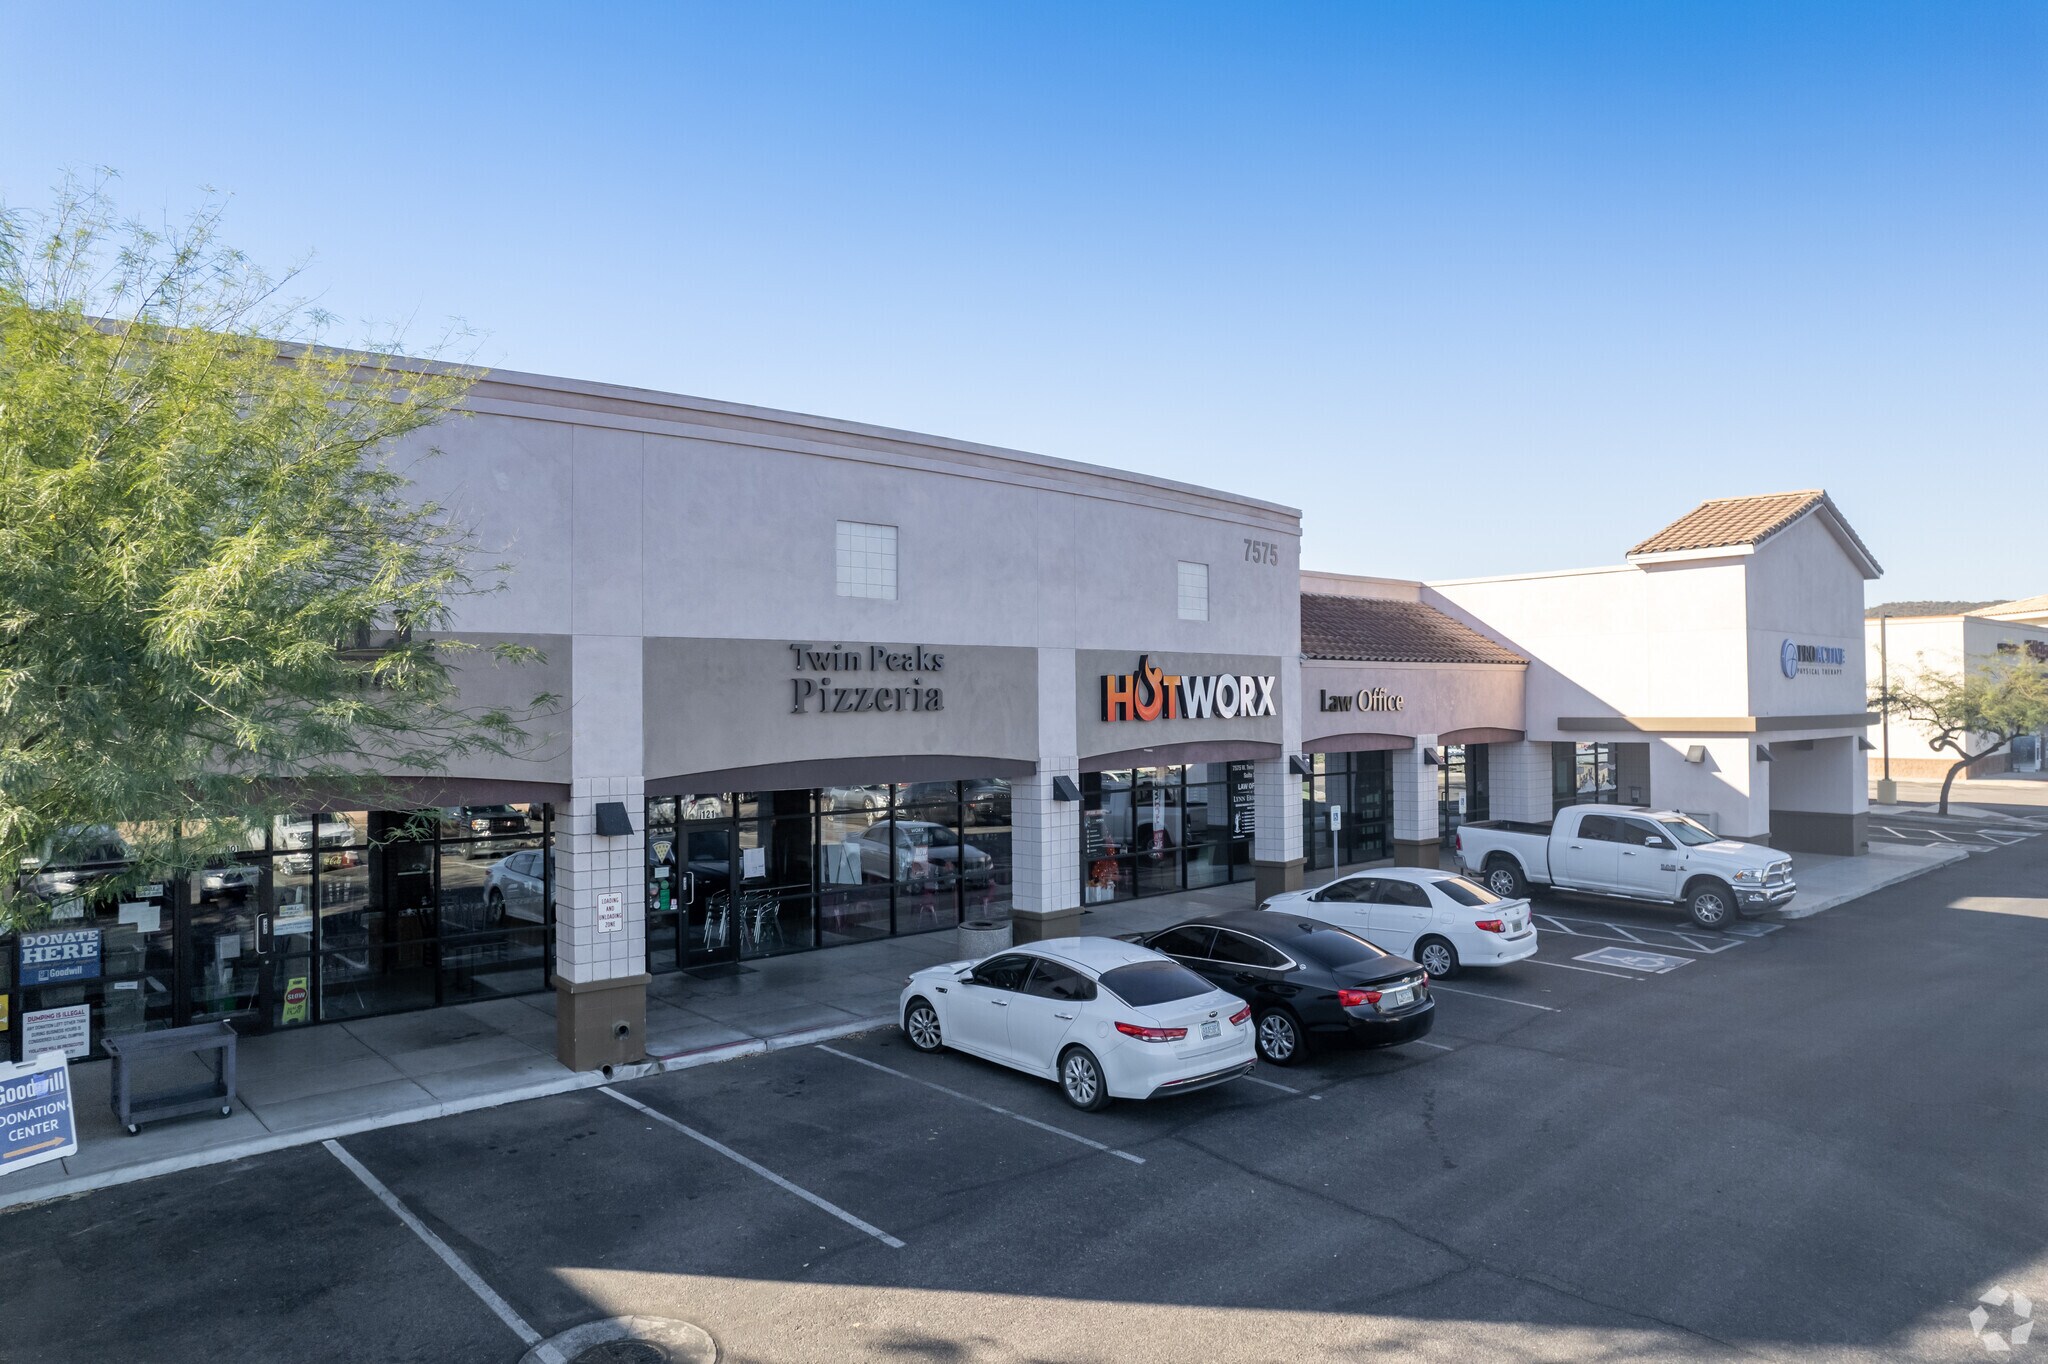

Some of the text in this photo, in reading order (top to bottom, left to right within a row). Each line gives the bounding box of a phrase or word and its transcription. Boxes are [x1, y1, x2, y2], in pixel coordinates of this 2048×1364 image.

[1243, 538, 1279, 566] 7575
[789, 643, 945, 672] Twin Peaks
[1797, 667, 1842, 676] PHYSICAL THERAPY
[790, 677, 945, 714] Pizzeria
[1100, 654, 1277, 723] HOTWORX
[1320, 687, 1404, 712] Law Office
[1238, 783, 1248, 791] LAW
[702, 810, 716, 819] 121
[601, 897, 619, 905] LOADING
[598, 913, 623, 921] UNLOADING
[22, 930, 98, 948] DONATE
[22, 941, 98, 964] HERE
[49, 965, 83, 978] Goodwill
[287, 992, 306, 1001] SLOW
[27, 1013, 54, 1022] DUMPING
[62, 1009, 84, 1017] ILLEGAL
[0, 1071, 65, 1106] oodill
[0, 1100, 66, 1128] DONATION
[8, 1119, 59, 1142] CENTER
